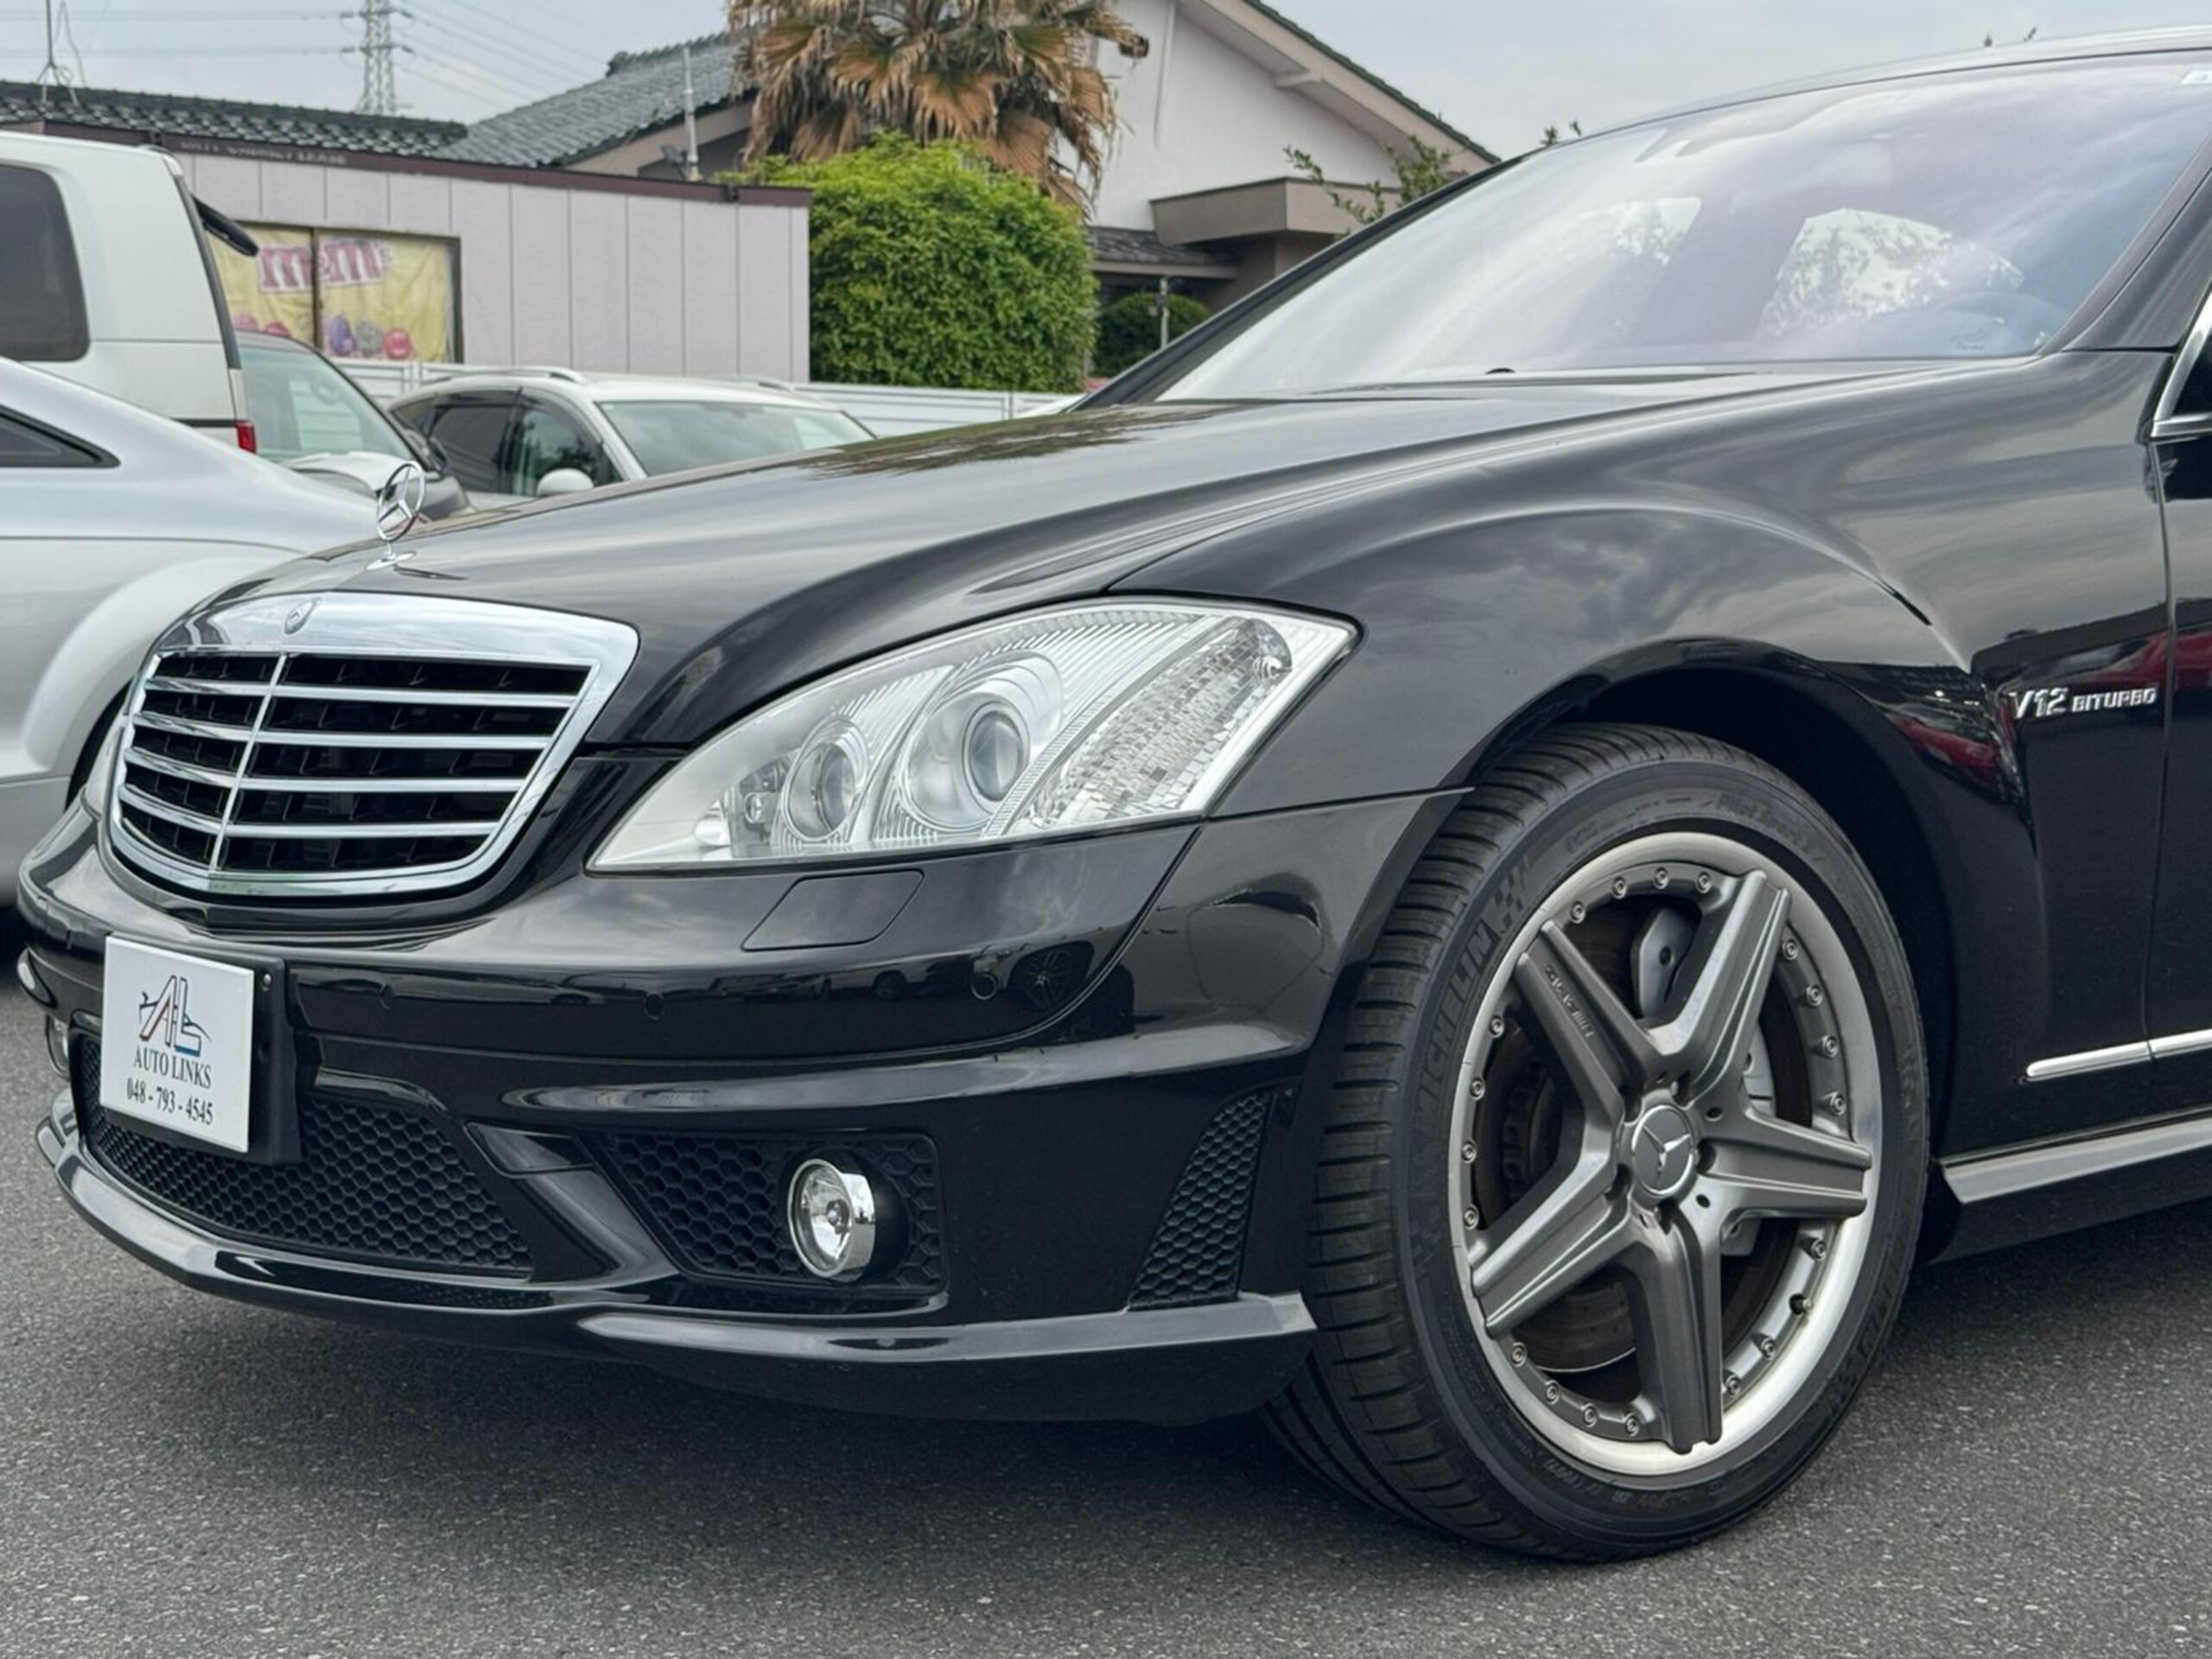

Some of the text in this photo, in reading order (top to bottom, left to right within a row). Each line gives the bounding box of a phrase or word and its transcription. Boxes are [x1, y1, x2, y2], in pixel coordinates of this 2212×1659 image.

[2008, 688, 2157, 719] V12 BITURBO
[133, 1046, 212, 1090] AUTO LINKS
